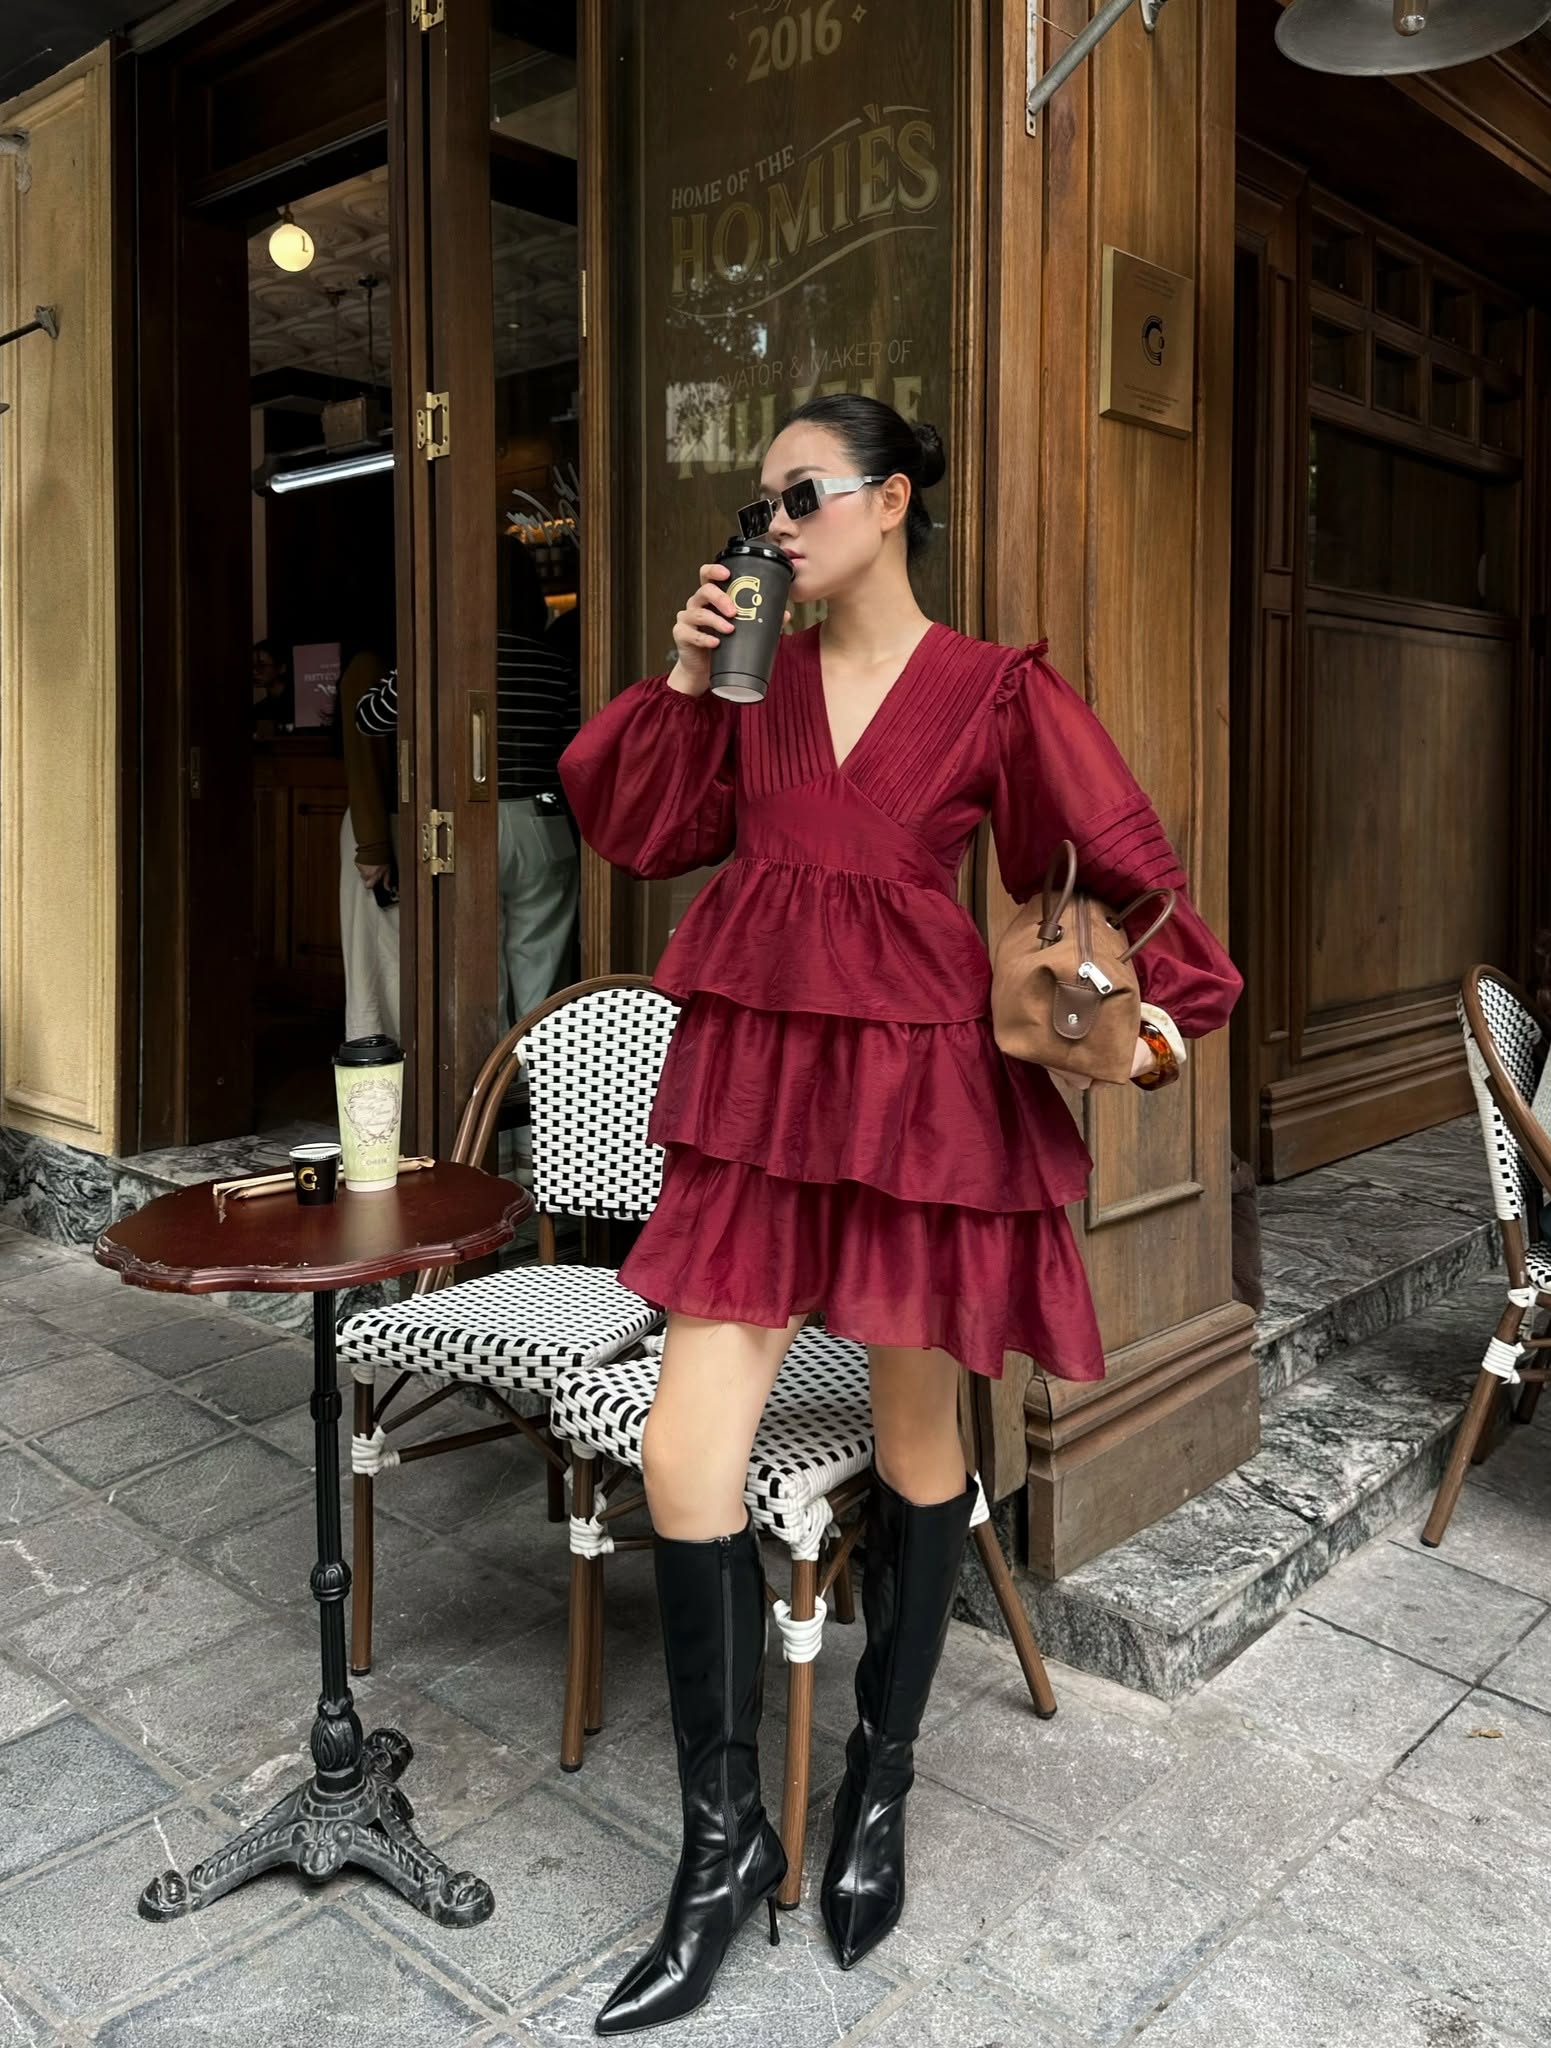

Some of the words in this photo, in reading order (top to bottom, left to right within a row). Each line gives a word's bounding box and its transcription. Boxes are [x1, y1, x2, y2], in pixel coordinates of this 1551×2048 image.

[746, 0, 842, 84] 2016
[671, 180, 722, 210] HOME
[726, 168, 749, 196] OF
[755, 146, 795, 183] THE
[789, 355, 803, 378] &
[808, 341, 881, 375] MAKER
[888, 339, 912, 364] OF
